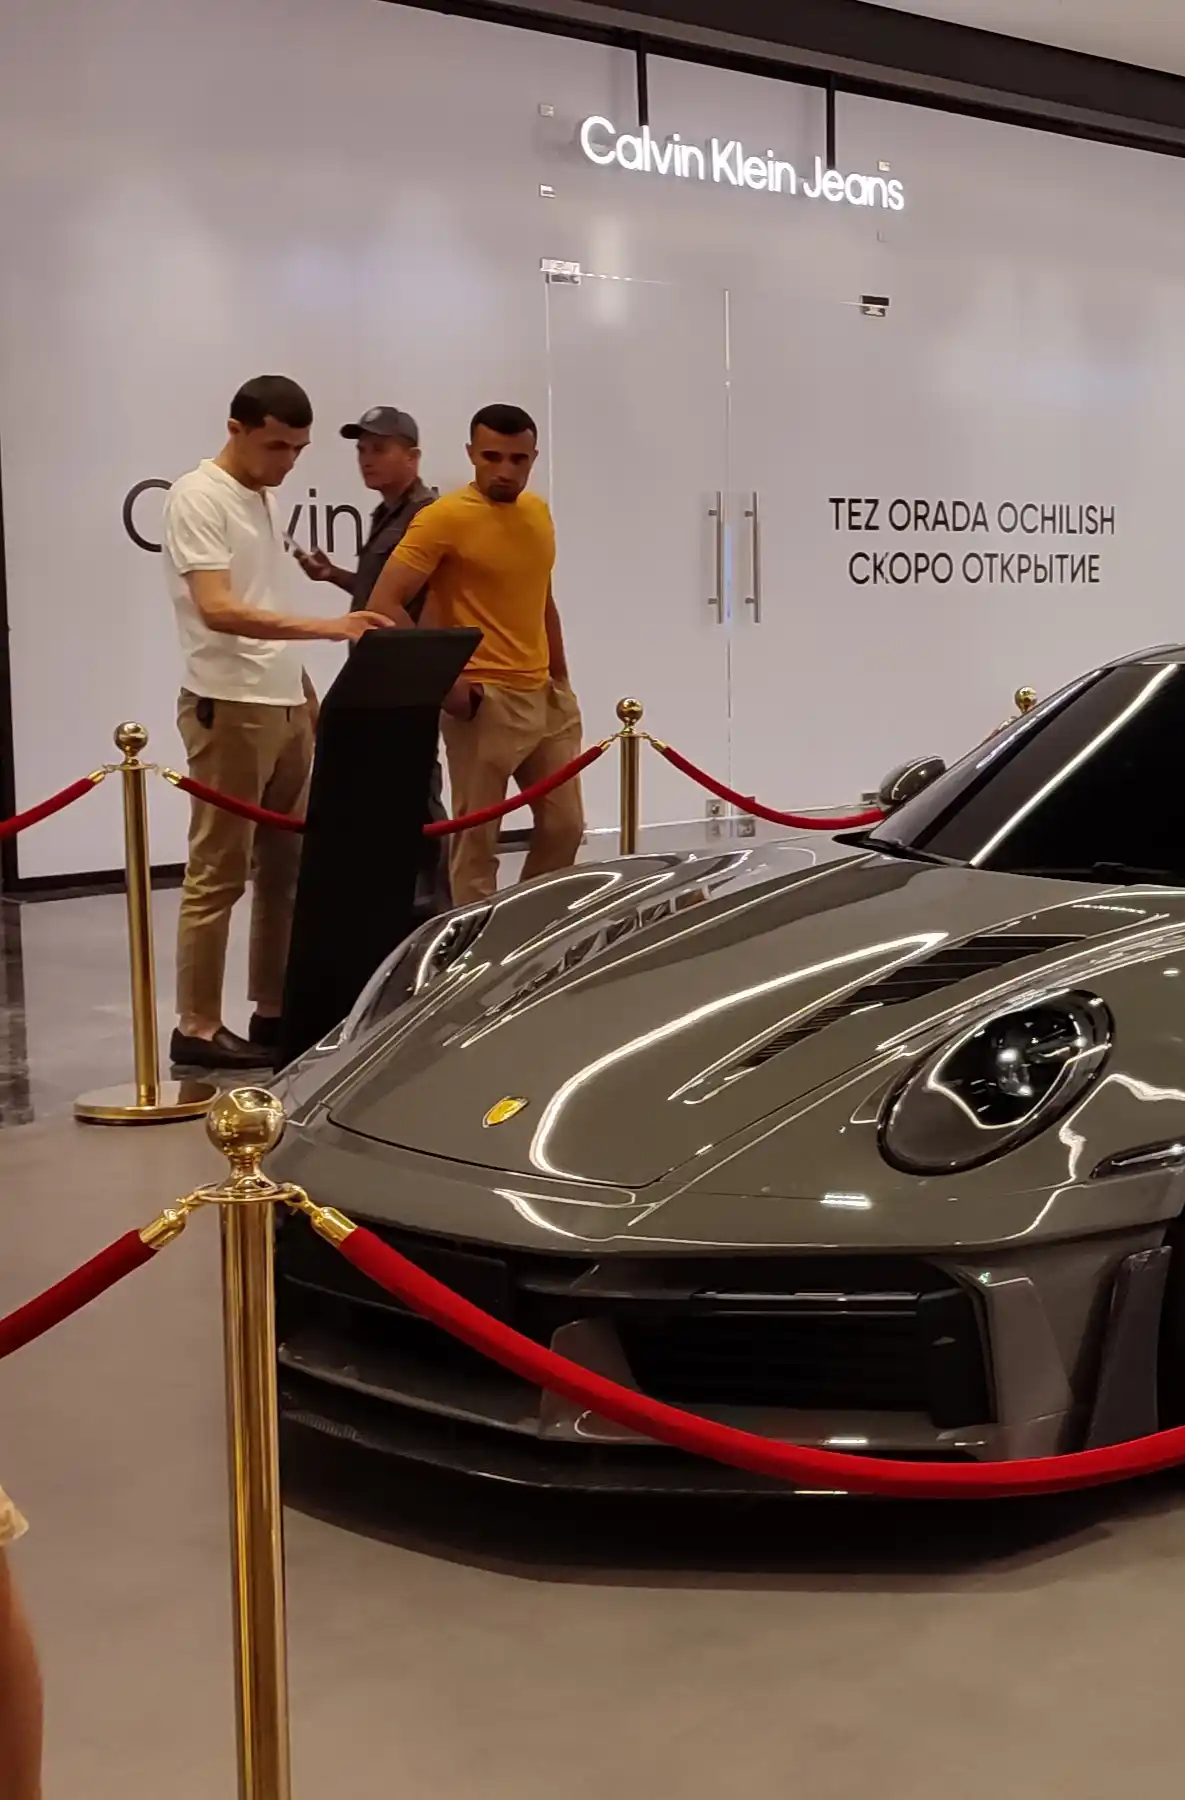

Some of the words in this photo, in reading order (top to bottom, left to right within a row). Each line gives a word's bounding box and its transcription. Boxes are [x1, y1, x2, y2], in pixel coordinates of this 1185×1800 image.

[580, 115, 705, 181] Calvin
[710, 137, 796, 195] Klein
[802, 155, 905, 211] Jeans
[121, 478, 364, 553] Cvin
[828, 497, 880, 531] TEZ
[888, 498, 989, 533] ORADA
[997, 501, 1116, 535] OCHILISH
[849, 551, 954, 585] СКОРО
[961, 552, 1101, 584] ОТКРЫТИЕ
